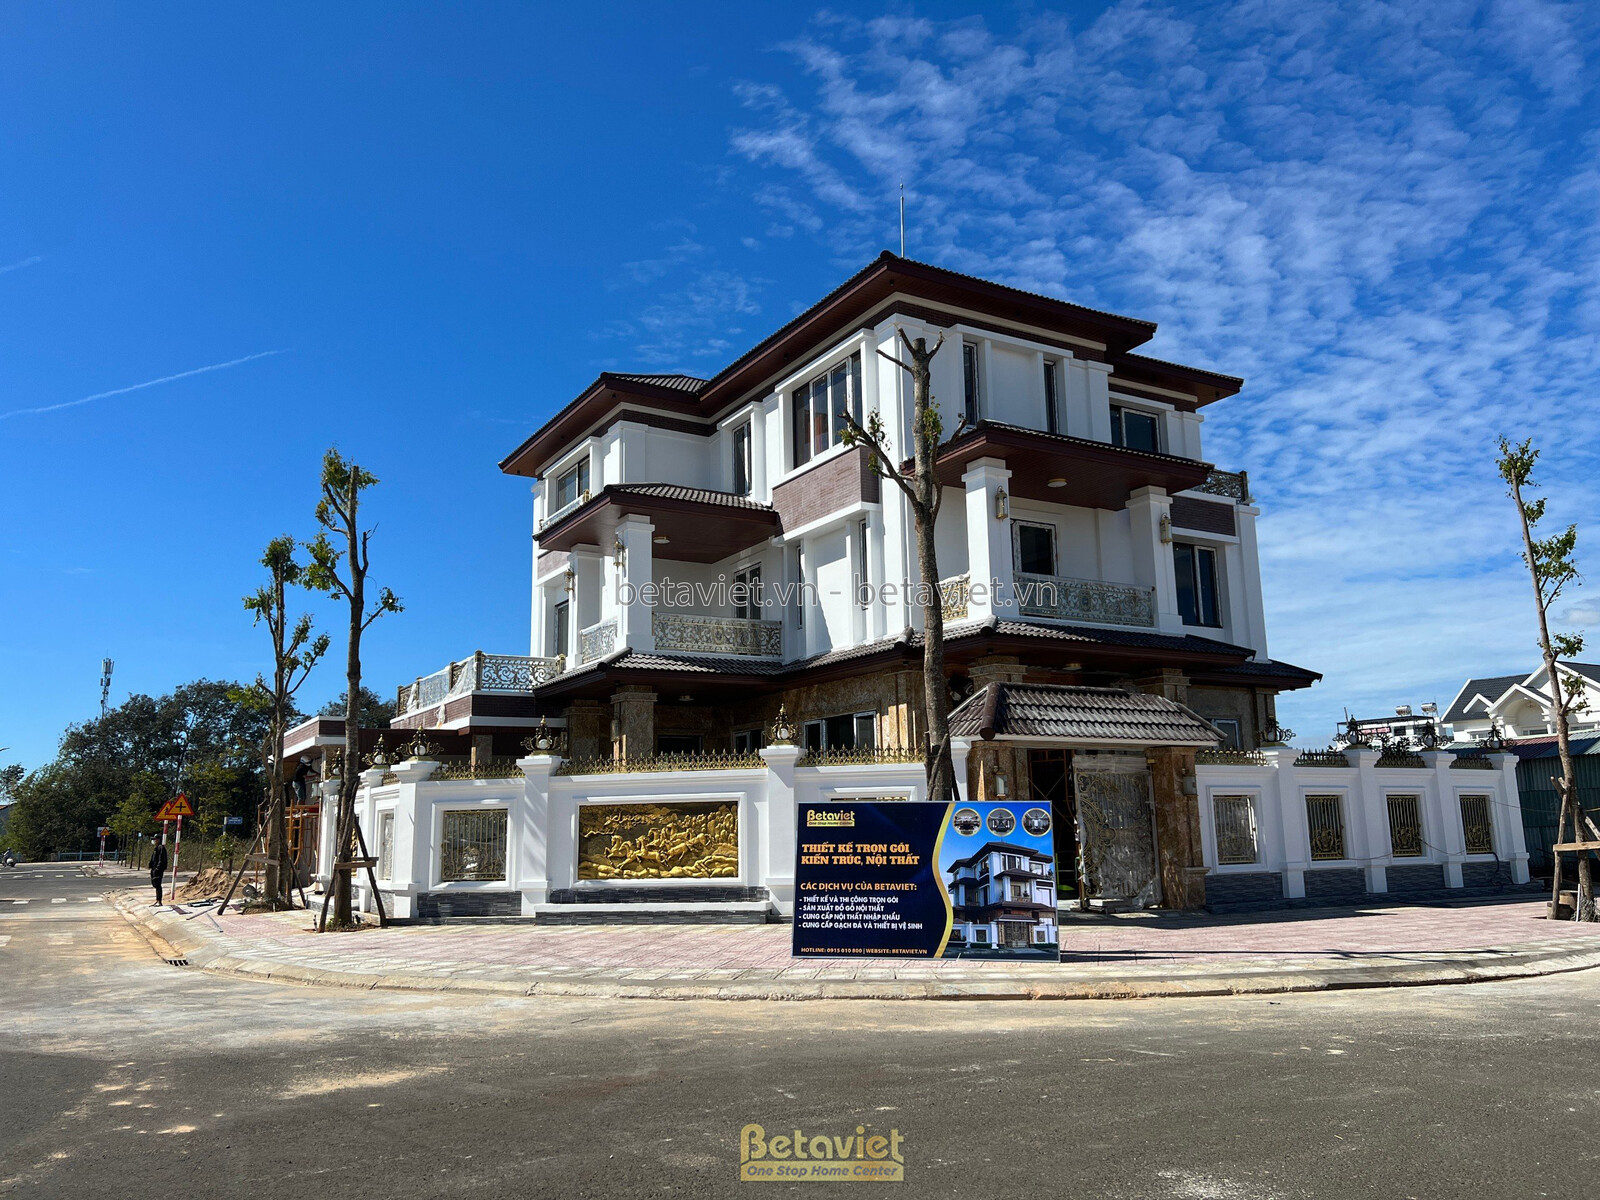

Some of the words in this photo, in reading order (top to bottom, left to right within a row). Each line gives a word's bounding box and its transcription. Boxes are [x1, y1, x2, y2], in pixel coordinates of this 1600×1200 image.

[807, 809, 855, 821] Betaviet
[801, 841, 836, 853] THIẾT
[837, 841, 854, 853] KẾ
[855, 844, 887, 855] TRỌN
[889, 842, 910, 853] GÓI
[801, 853, 829, 865] KIẾN
[832, 854, 864, 866] TRÚC,
[865, 854, 887, 867] NỘI
[889, 853, 920, 865] THẤT
[800, 882, 818, 890] CÁC
[819, 883, 840, 892] DỊCH
[841, 883, 854, 892] VỤ
[855, 881, 873, 890] CỦA
[874, 883, 918, 891] BETAVIET:
[803, 894, 820, 903] THIẾT
[829, 894, 839, 903] VÀ
[850, 895, 868, 903] CÔNG
[886, 895, 899, 903] GÓI
[802, 921, 820, 929] CUNG
[863, 921, 873, 929] VÀ
[907, 922, 923, 930] SINH
